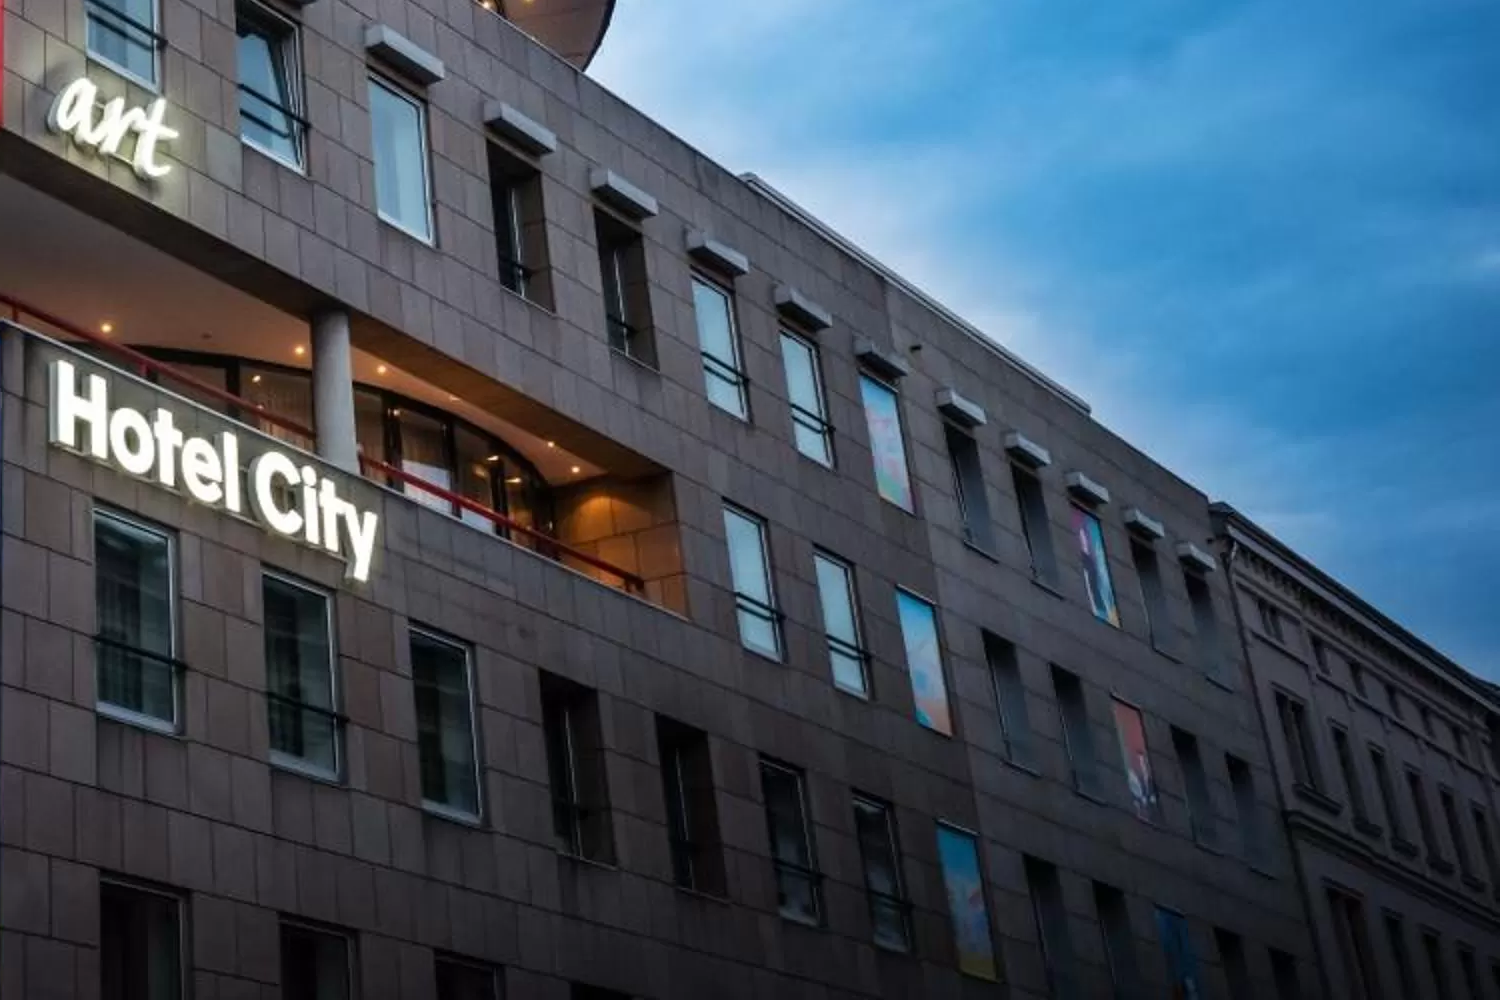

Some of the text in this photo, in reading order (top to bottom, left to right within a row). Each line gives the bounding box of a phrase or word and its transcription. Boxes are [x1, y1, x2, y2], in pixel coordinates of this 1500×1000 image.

[49, 77, 180, 180] art
[49, 360, 378, 582] Hotel City
